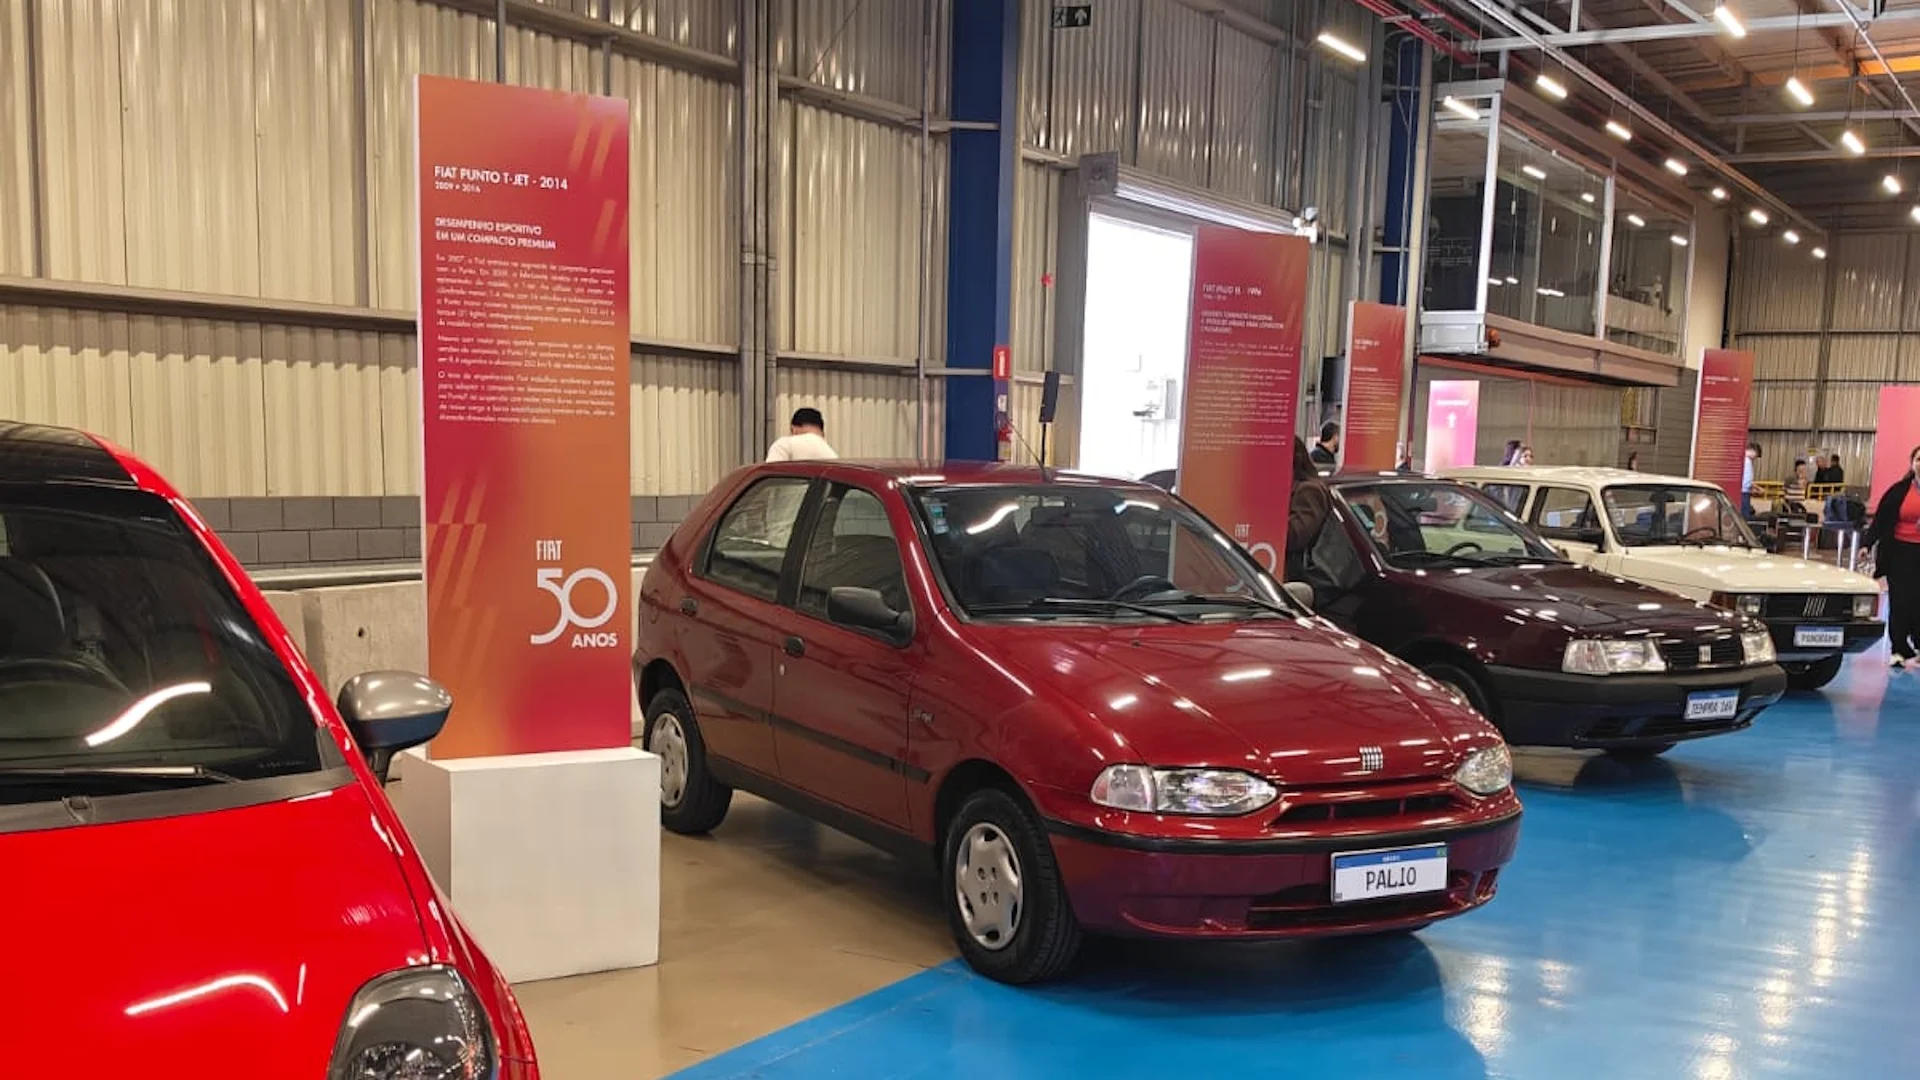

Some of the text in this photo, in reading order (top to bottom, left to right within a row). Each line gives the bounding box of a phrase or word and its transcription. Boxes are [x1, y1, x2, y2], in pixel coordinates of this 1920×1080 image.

[435, 166, 457, 179] FIAT
[460, 168, 500, 184] PUNTO
[503, 172, 529, 186] T-JET
[540, 176, 568, 190] 2014
[435, 217, 542, 236] DESEMPENHO ESPORTIVO
[436, 231, 556, 250] EM UM COMPACTO PREMIUM
[536, 540, 562, 561] FIAT
[531, 567, 618, 645] 50
[572, 633, 618, 648] ANOS
[1366, 867, 1417, 891] PALIO
